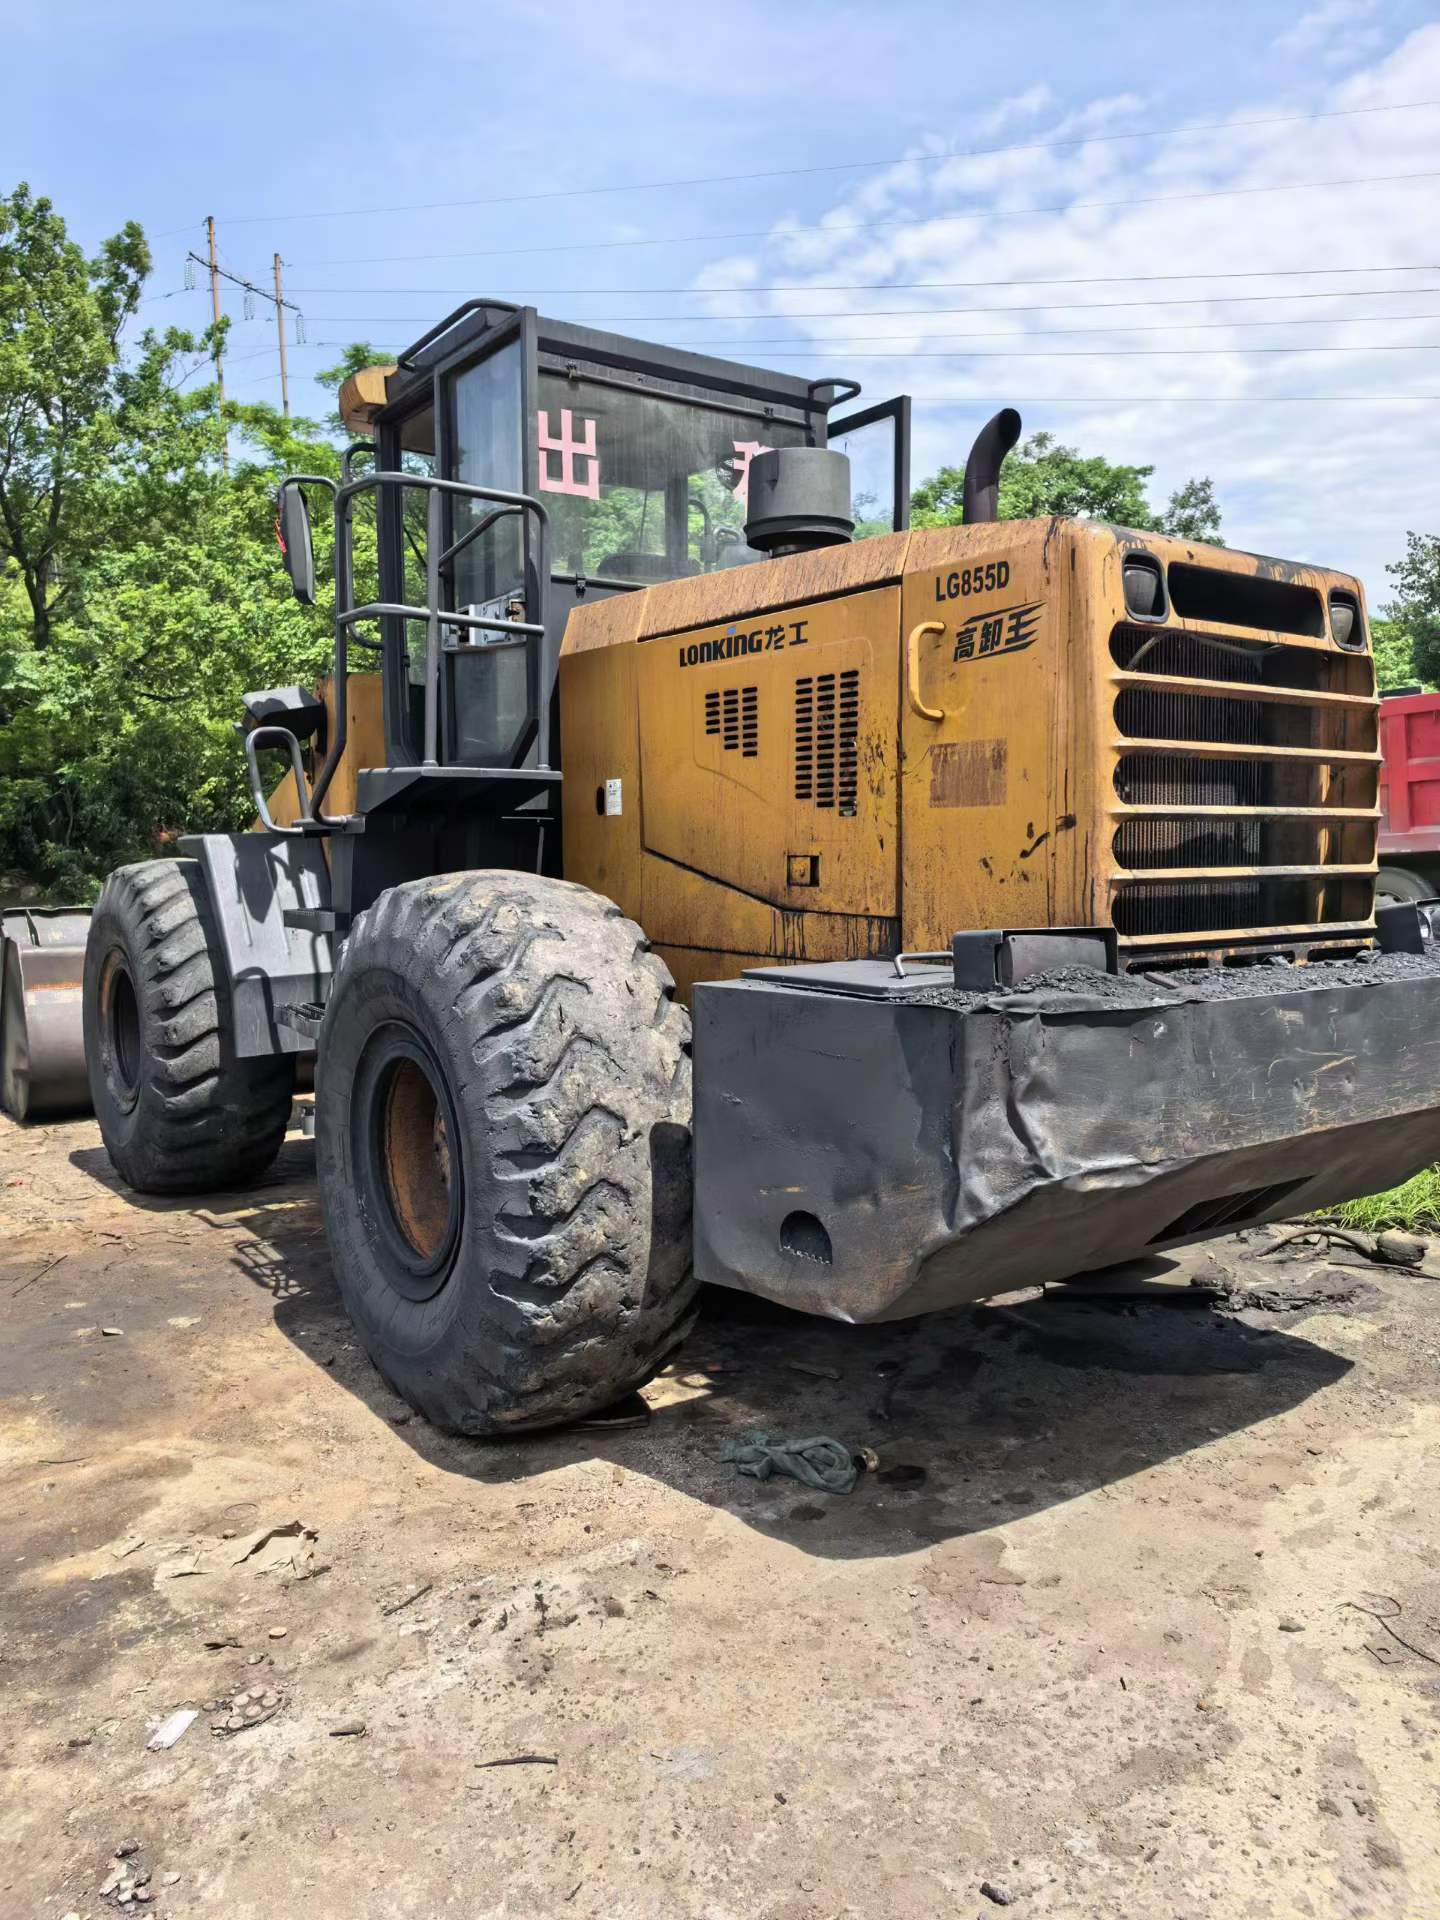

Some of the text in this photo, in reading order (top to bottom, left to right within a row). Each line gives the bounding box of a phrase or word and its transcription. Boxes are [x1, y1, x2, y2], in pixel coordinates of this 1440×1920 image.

[537, 409, 600, 501] 出
[935, 560, 1010, 602] LG855D
[953, 602, 1046, 662] 高卸王
